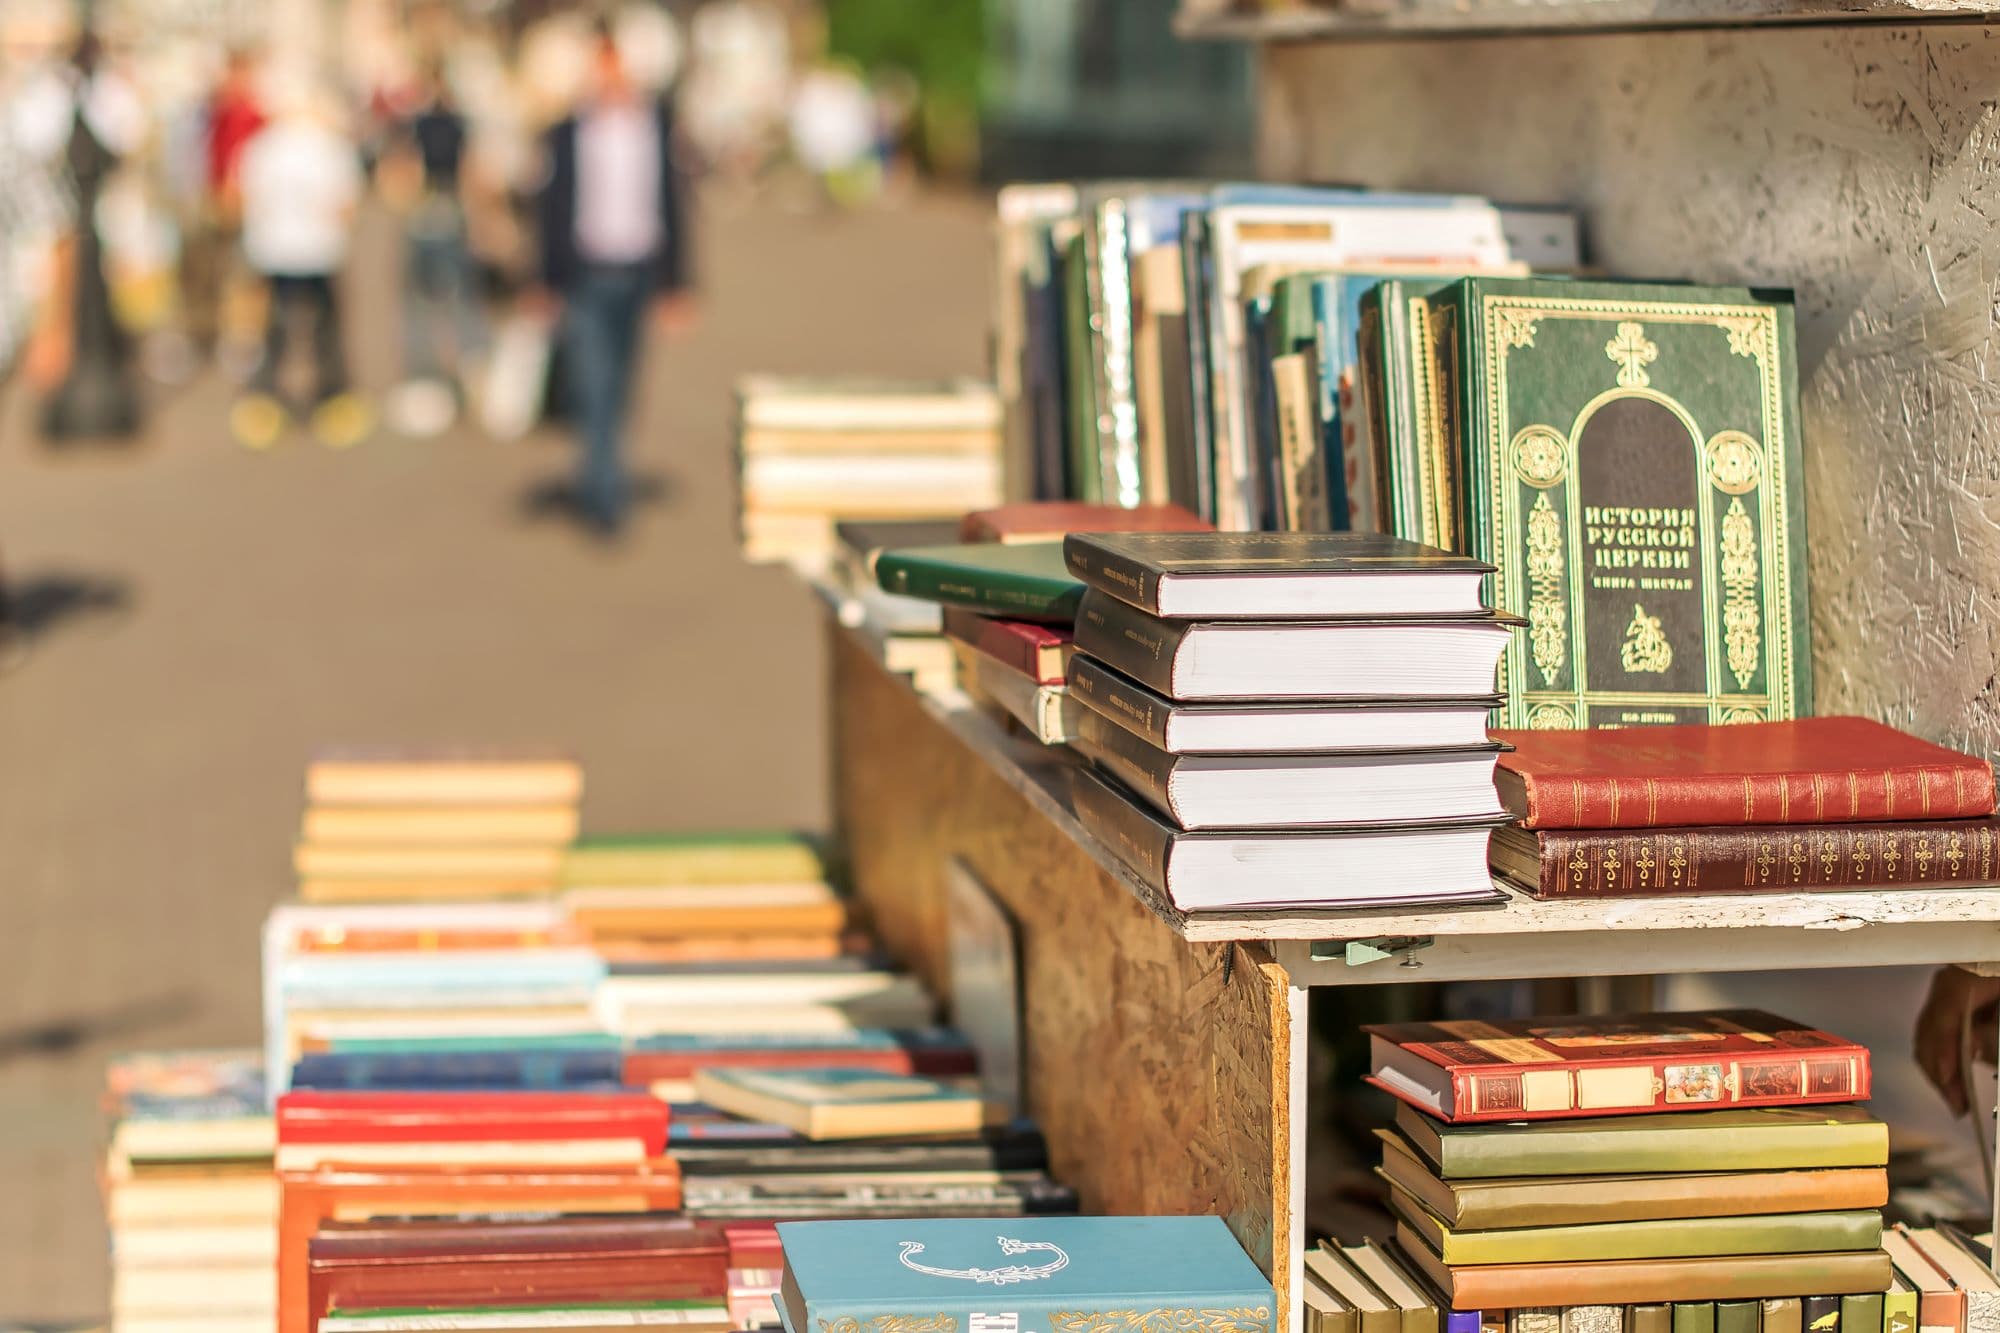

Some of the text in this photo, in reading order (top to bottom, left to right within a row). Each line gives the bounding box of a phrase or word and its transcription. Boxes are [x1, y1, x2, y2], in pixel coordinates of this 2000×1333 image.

[1585, 506, 1696, 527] ИСТОРИЯ
[1587, 526, 1695, 547] РУССКОЙ
[1595, 548, 1691, 570] ЦЕРКВИ
[1593, 576, 1694, 591] КНИГА ШЕСТАЯ
